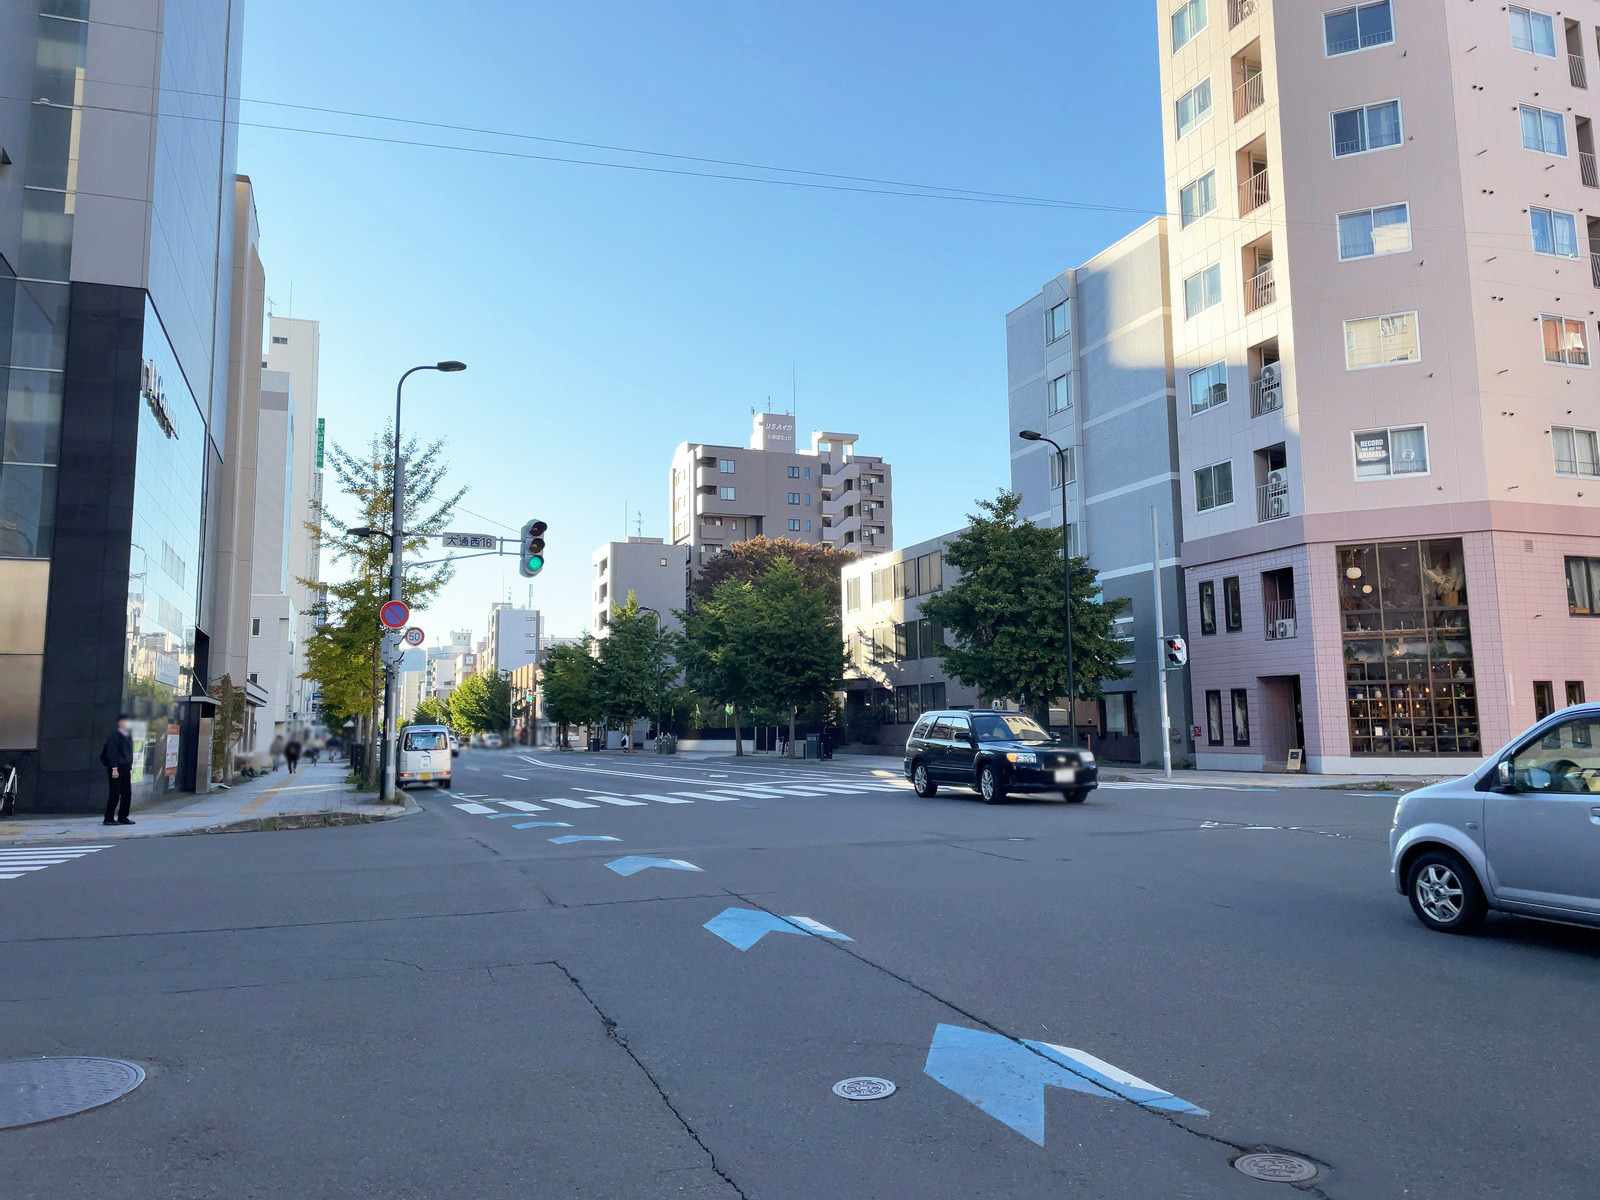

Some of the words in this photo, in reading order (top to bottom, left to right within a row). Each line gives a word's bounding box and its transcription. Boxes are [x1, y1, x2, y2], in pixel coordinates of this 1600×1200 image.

[1360, 439, 1384, 447] RECORD
[446, 536, 492, 548] 大通西16
[408, 631, 421, 642] 50
